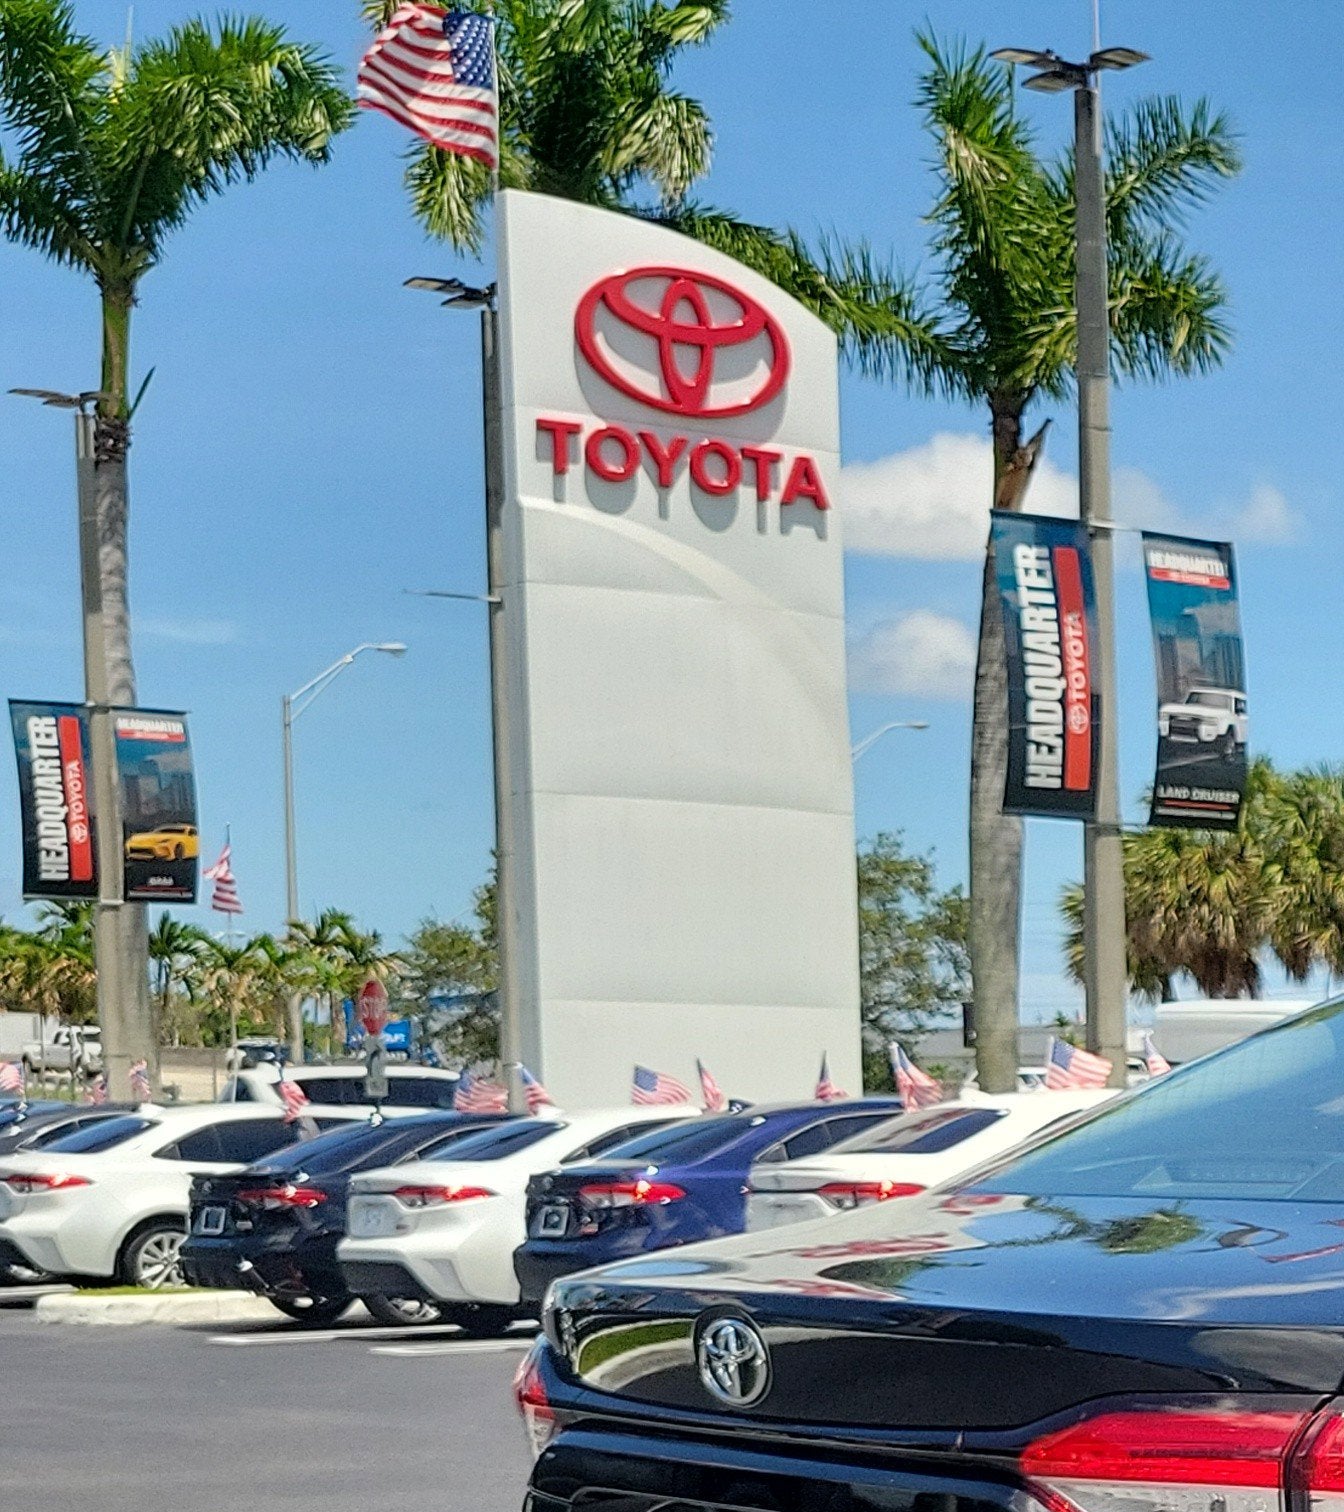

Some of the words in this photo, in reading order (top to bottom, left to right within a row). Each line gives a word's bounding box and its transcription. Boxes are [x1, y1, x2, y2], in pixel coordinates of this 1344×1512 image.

[536, 417, 829, 511] TOYOTA
[1013, 543, 1067, 788] HEADQUARTER
[1066, 610, 1088, 702] TOYOTA
[27, 716, 69, 882] HEADQUARTER
[66, 759, 88, 822] TOYOTA
[1156, 784, 1191, 800] LAND
